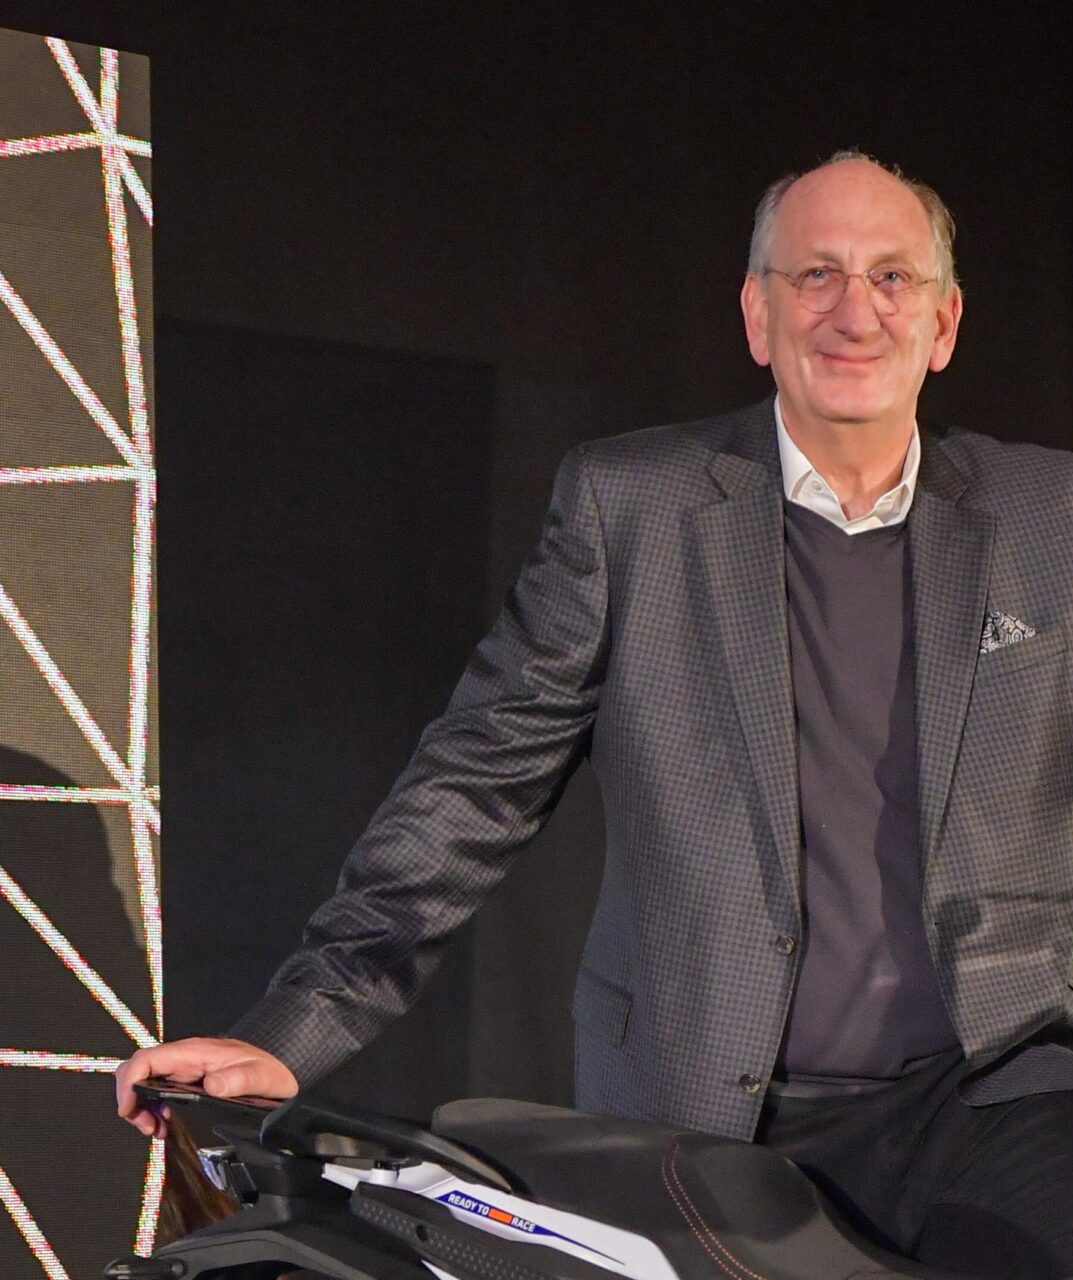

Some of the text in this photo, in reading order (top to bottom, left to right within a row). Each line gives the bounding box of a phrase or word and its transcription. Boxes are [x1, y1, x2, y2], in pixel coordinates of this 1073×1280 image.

[447, 1193, 535, 1233] READY TO RACE
